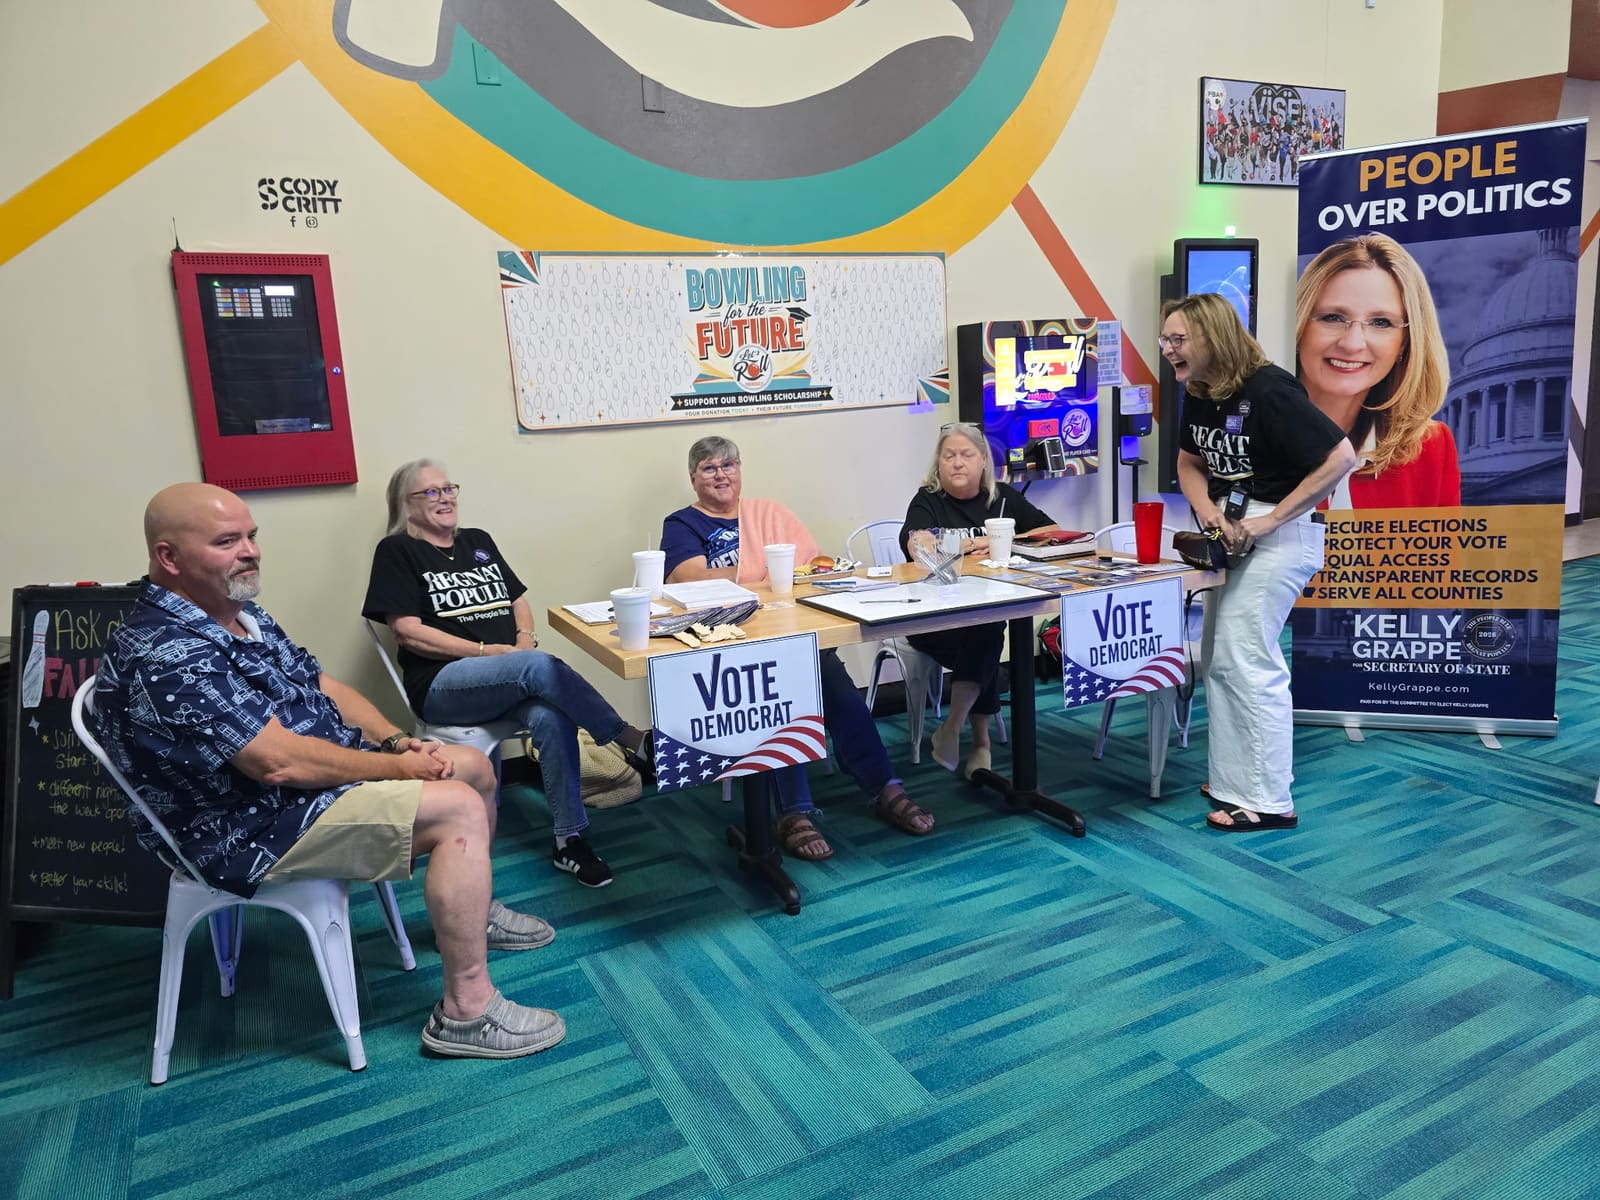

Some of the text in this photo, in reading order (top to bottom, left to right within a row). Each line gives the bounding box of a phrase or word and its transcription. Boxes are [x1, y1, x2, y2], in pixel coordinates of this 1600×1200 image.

[1359, 141, 1518, 194] PEOPLE
[280, 177, 338, 196] CODY
[282, 195, 342, 214] CRITT
[1318, 178, 1573, 231] OVER POLITICS
[686, 266, 807, 312] BOWLING
[722, 302, 766, 328] for the
[696, 317, 806, 360] FUTURE
[683, 390, 822, 408] SUPPORT OUR BOWLING SCHOLARSHIP
[1389, 518, 1488, 534] ELECTIONS
[1400, 537, 1453, 550] YOUR
[1457, 536, 1507, 549] VOTE
[1379, 554, 1451, 567] ACCESS
[1318, 569, 1539, 584] TRANSPARENT RECORDS
[1317, 586, 1504, 600] SERVE ALL COUNTIES
[457, 613, 474, 624] The
[474, 609, 499, 621] People
[1092, 593, 1154, 641] VOTE
[1354, 614, 1462, 639] KELLY
[1090, 635, 1163, 667] DEMOCRAT
[1352, 640, 1462, 661] GRAPPE
[1363, 662, 1442, 674] SECRETARY
[1445, 663, 1463, 674] OF
[1465, 664, 1511, 676] STATE
[692, 653, 779, 711] VOTE
[1368, 682, 1470, 694] KellyGrappe.com
[690, 701, 793, 743] DEMOCRAT
